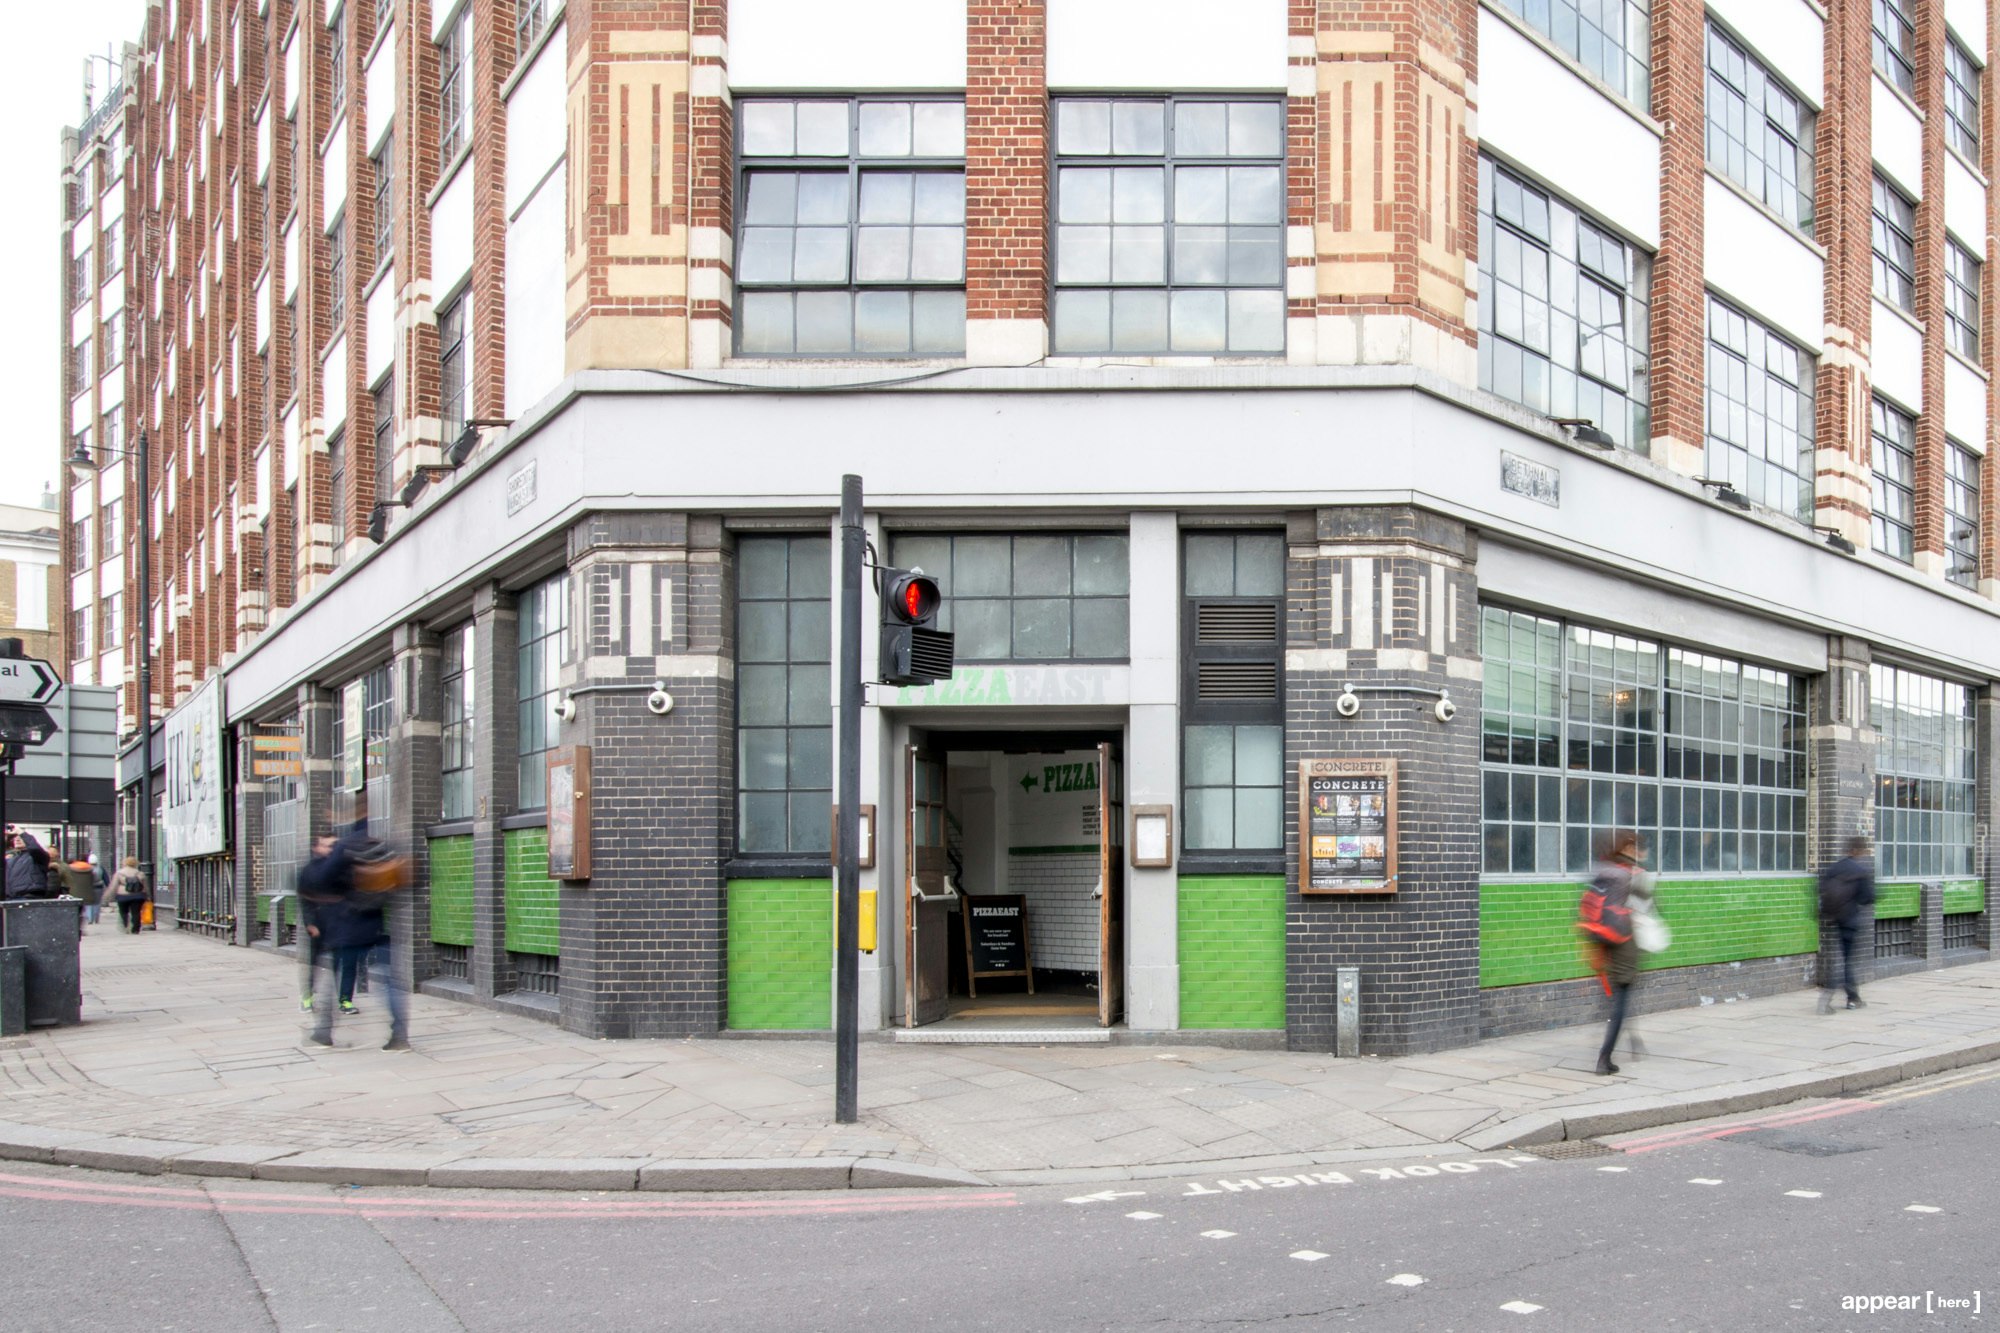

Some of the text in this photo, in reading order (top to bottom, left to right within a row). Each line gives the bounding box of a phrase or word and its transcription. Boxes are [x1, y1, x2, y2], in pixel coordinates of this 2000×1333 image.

[1315, 762, 1382, 772] CONCRETE
[1313, 781, 1385, 790] CONCRETE
[973, 907, 1019, 916] PIZZAEAST
[1182, 1156, 1538, 1196] LOOK RIGHT
